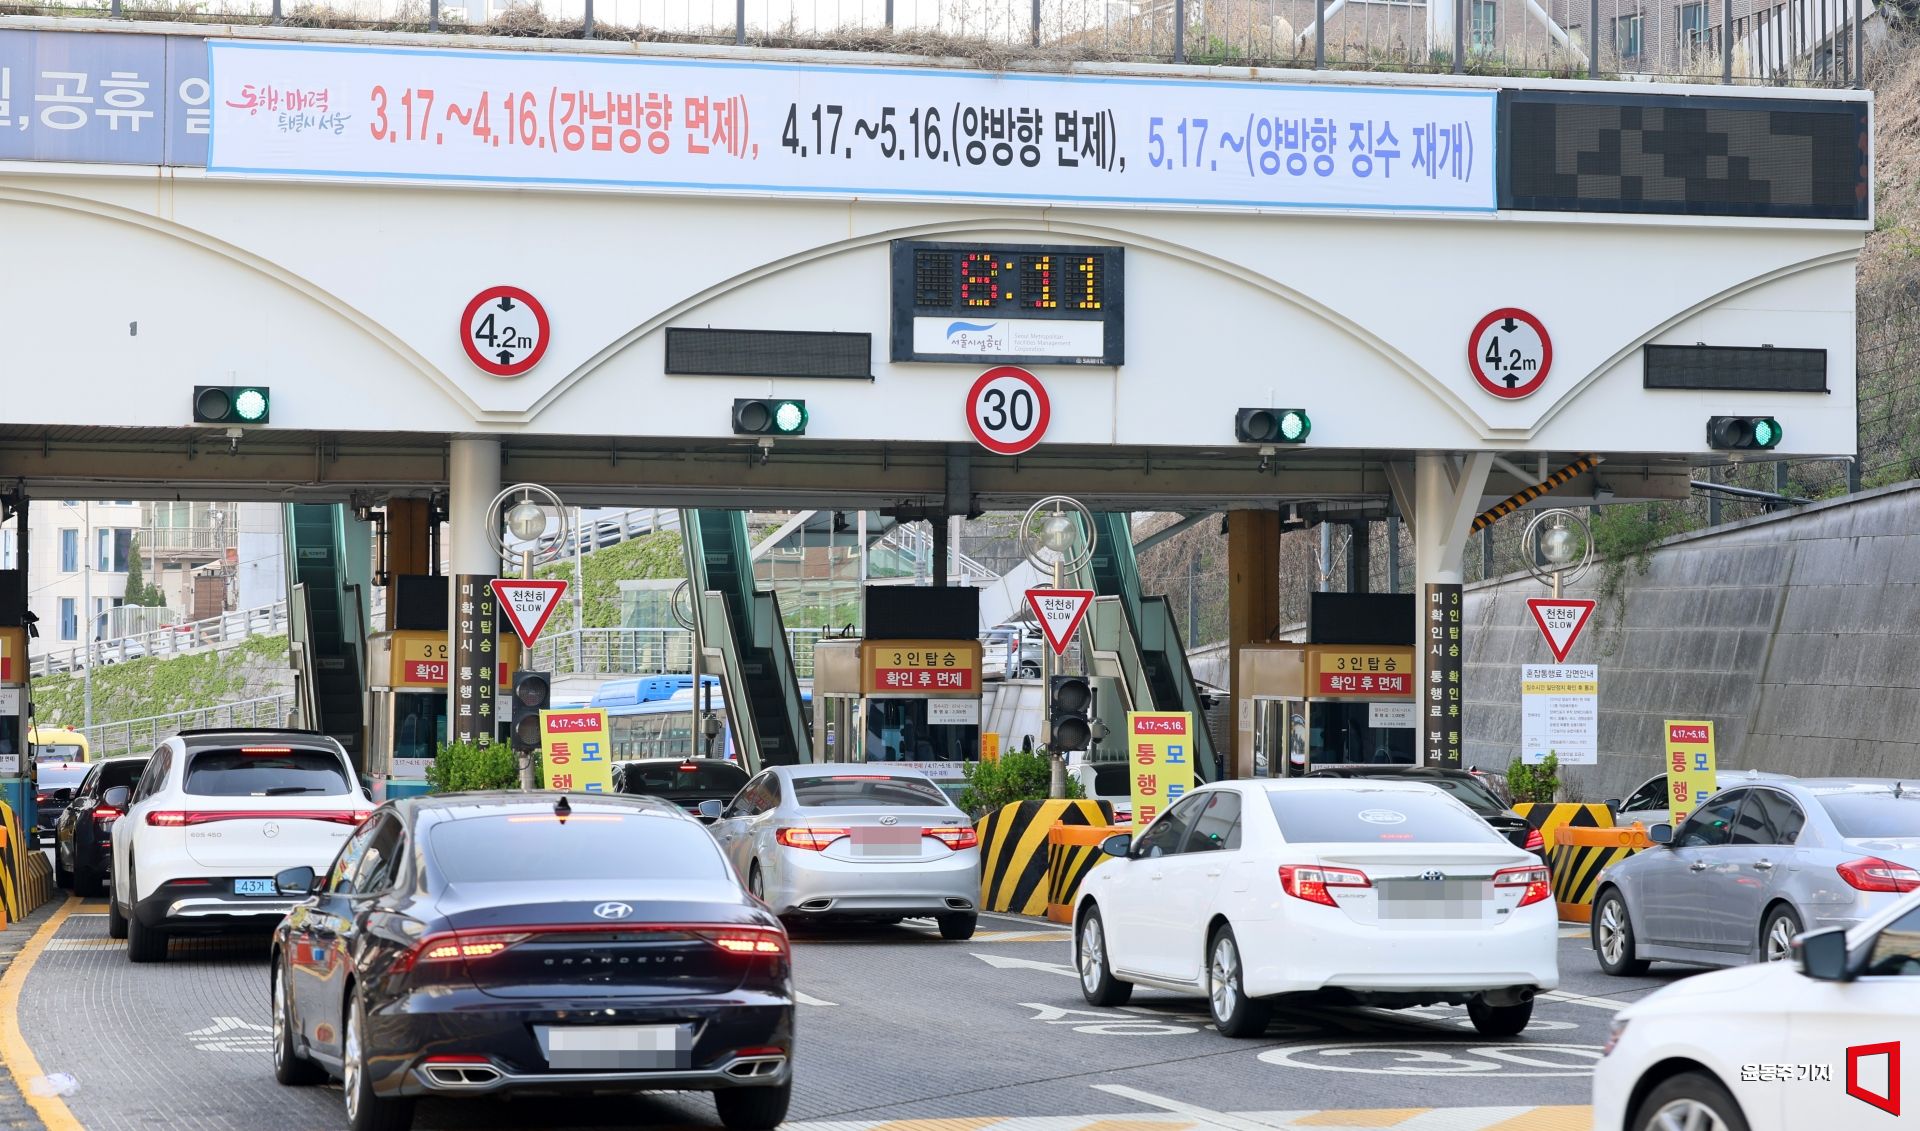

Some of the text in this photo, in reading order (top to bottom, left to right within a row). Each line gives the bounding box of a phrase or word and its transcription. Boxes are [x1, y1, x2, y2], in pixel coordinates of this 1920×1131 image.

[0, 68, 154, 131] ,공휴
[277, 112, 352, 135] 특별시 서울
[684, 94, 760, 160] 면제),
[1055, 108, 1126, 173] 면제),
[1348, 120, 1400, 178] 징수
[1411, 121, 1474, 182] 재개)
[961, 253, 1101, 308] 8:11
[475, 313, 532, 349] 4.2m
[950, 333, 1003, 352] 서울시설공단
[1485, 336, 1537, 371] 4.2m
[983, 388, 1033, 431] 30
[513, 590, 546, 603] 천천히
[515, 603, 542, 612] SLOW
[1044, 599, 1075, 611] 천천히
[1047, 612, 1071, 620] SLOW
[1546, 608, 1576, 620] 천천히
[1548, 621, 1572, 629] SLOW
[415, 663, 444, 680] 확인
[886, 671, 962, 687] 확인 후 면제
[1330, 675, 1402, 691] 확인 후 면제
[550, 718, 599, 728] 4.17.~5.16.
[1137, 721, 1184, 731] 4.17.~5.16.
[1672, 730, 1707, 739] 4.17.~5.16.
[1430, 731, 1442, 761] 부과
[1447, 731, 1459, 761] 통과
[543, 955, 686, 966] GRANDEUR
